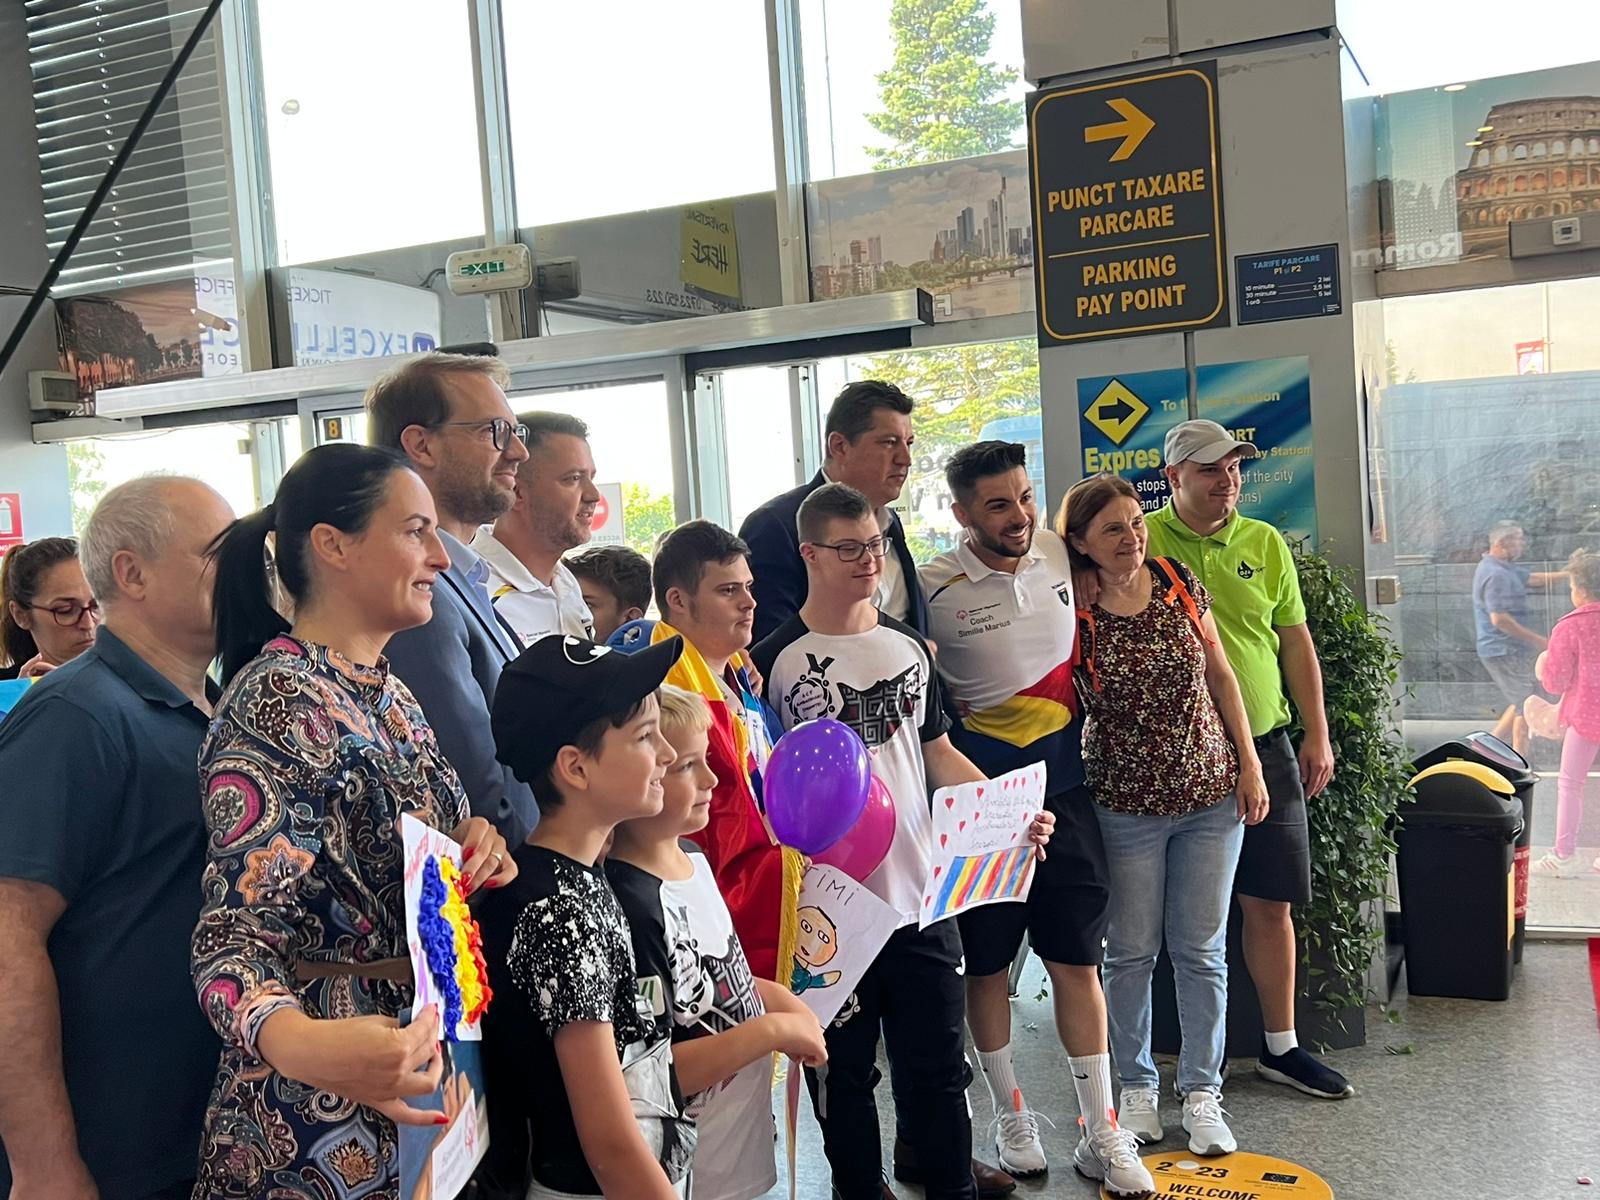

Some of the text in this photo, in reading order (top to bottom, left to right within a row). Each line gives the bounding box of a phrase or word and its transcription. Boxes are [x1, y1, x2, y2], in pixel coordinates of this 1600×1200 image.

[1047, 168, 1205, 212] PUNCT TAXARE
[1080, 204, 1174, 238] PARCARE
[460, 261, 504, 276] EXIT
[1253, 254, 1320, 269] TARIFE PARCARE
[1083, 254, 1177, 287] PARKING
[1274, 267, 1282, 275] P1
[1291, 265, 1301, 273] P2
[1076, 283, 1186, 318] PAY POINT
[1160, 399, 1177, 411] To
[328, 420, 338, 438] 8
[1240, 469, 1294, 484] of the city
[1137, 480, 1166, 493] stops
[1140, 496, 1160, 510] and
[969, 614, 994, 626] Coach
[984, 620, 1011, 632] Marius
[1169, 1183, 1262, 1200] WELCOME
